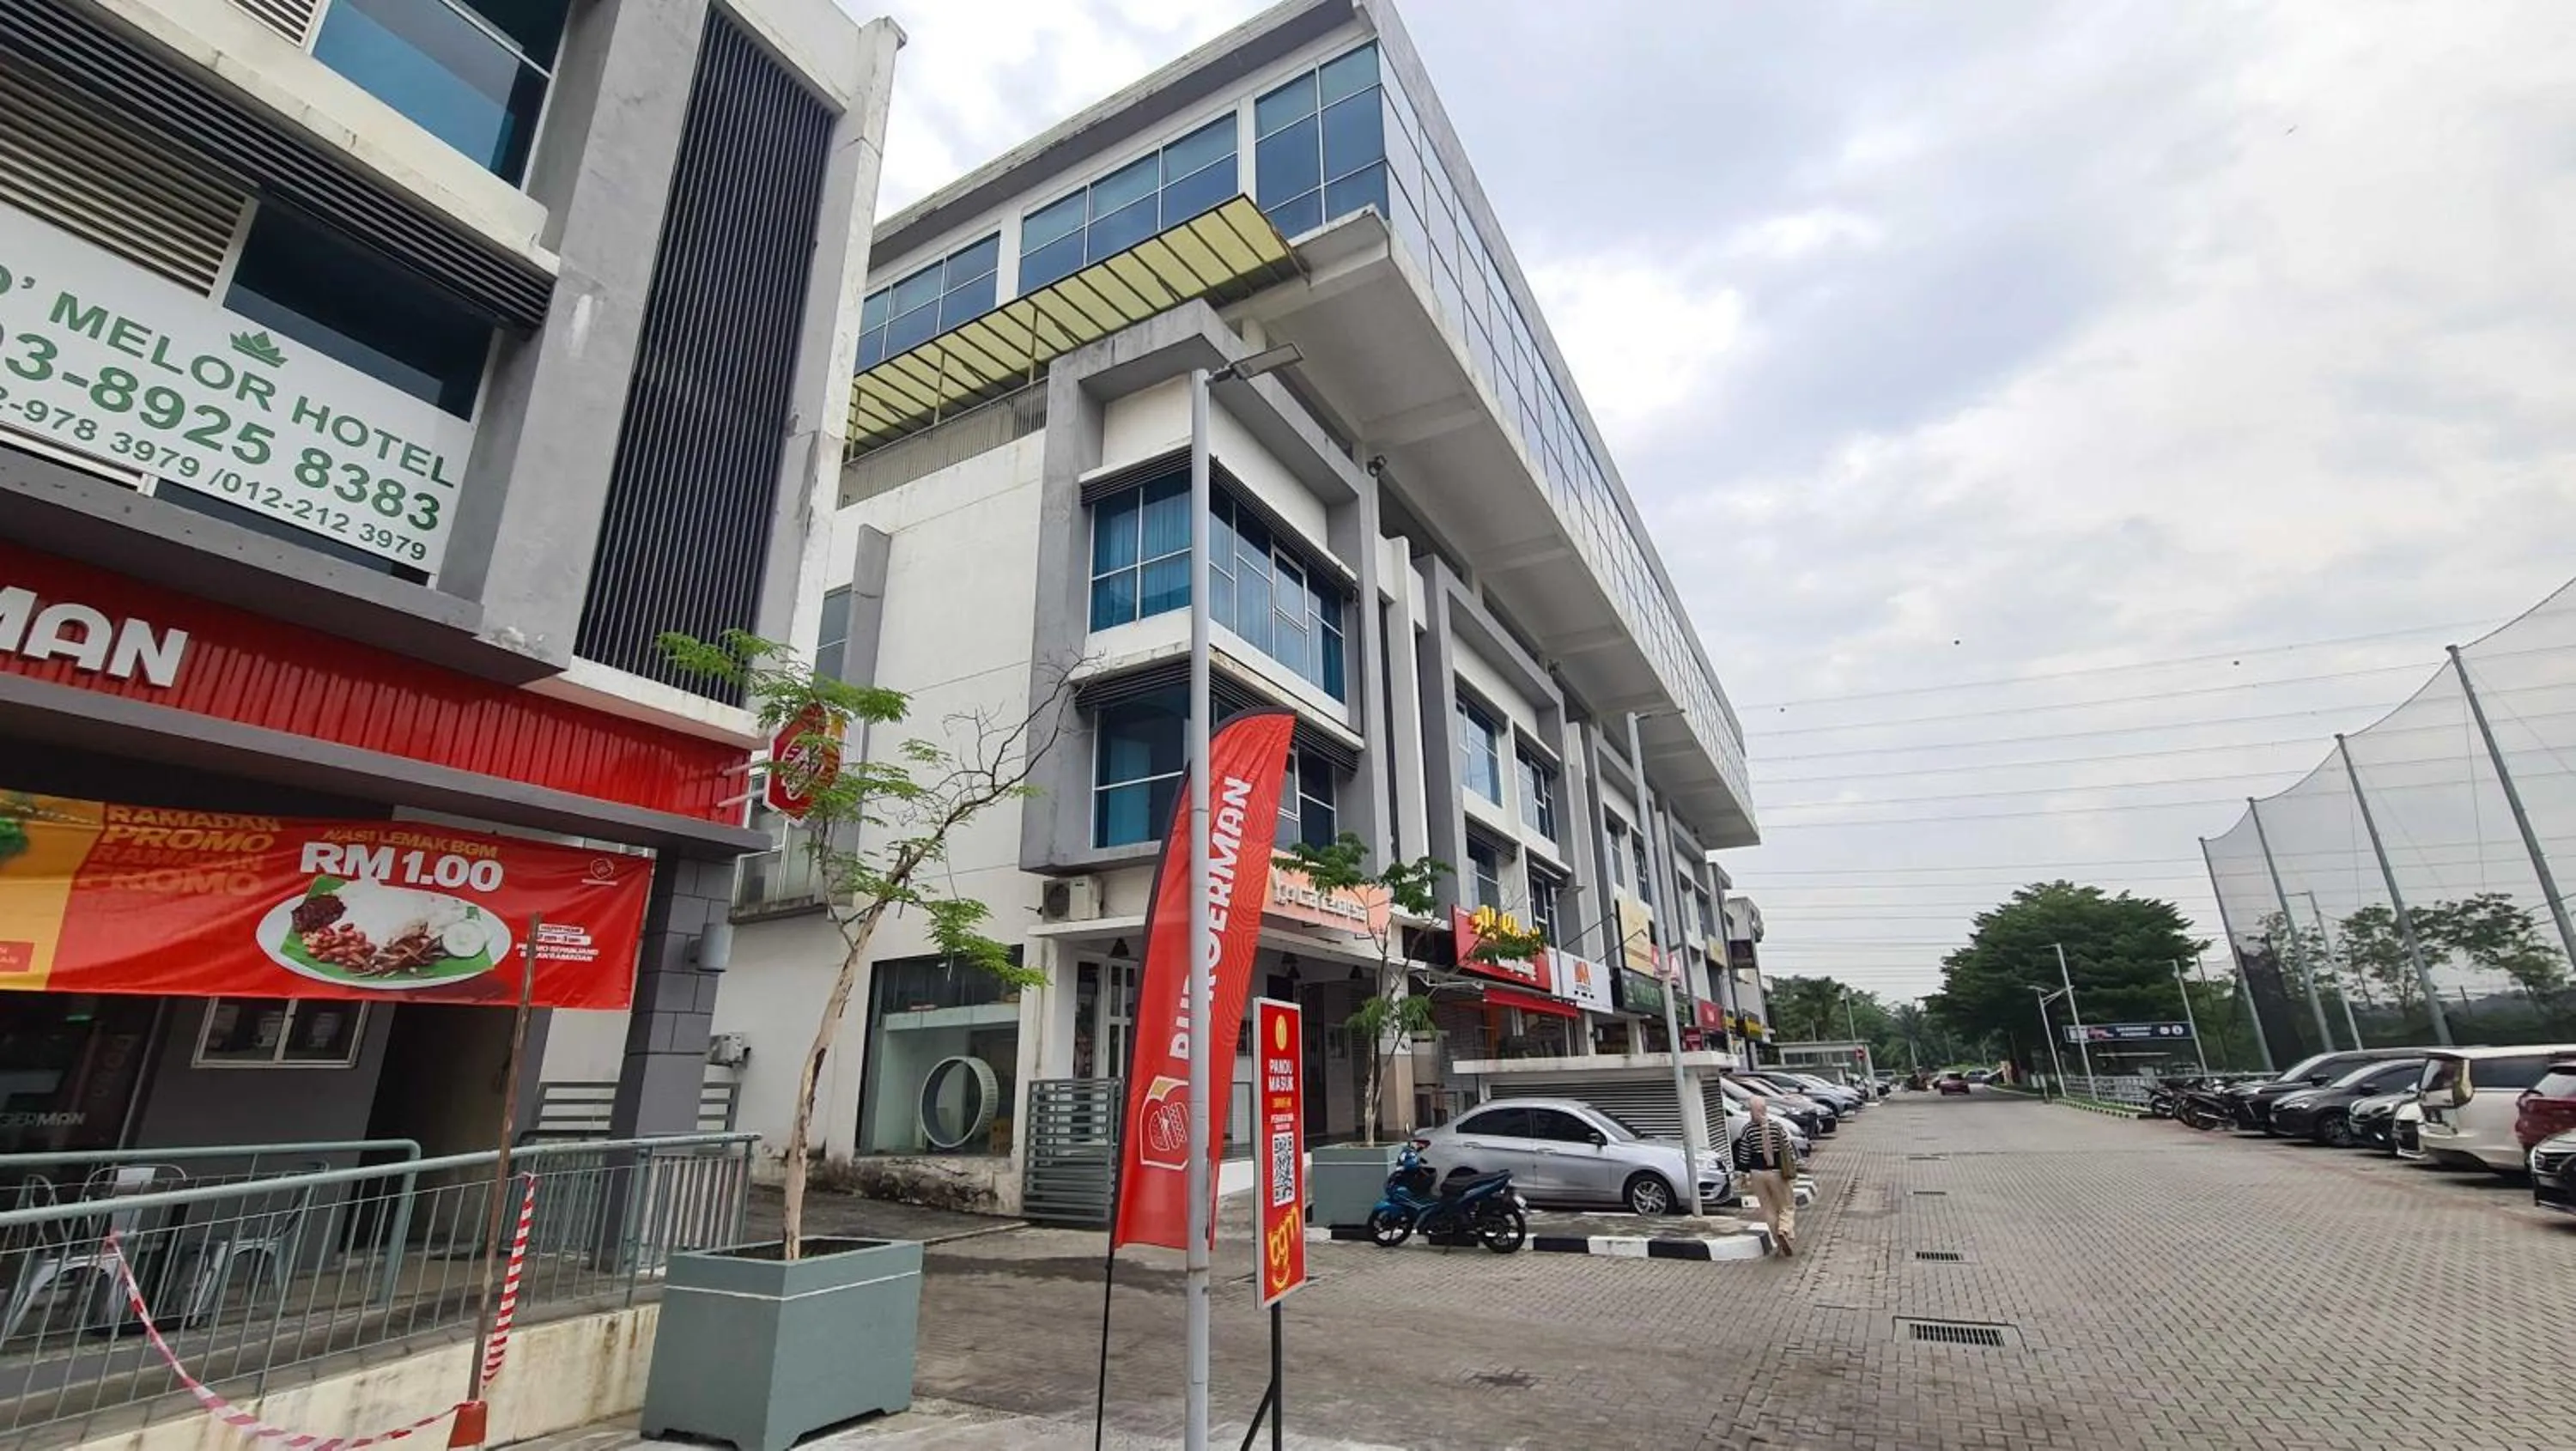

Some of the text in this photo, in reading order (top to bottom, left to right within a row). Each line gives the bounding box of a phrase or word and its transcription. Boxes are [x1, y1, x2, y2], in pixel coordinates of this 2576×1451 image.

[48, 291, 276, 412] MELOR
[291, 395, 455, 488] HOTEL
[0, 321, 441, 531] 3-8925 8383
[110, 432, 200, 477] 3979
[208, 467, 349, 533] /012-212
[358, 522, 426, 562] 3979
[99, 823, 275, 853] PROMO
[107, 805, 283, 832] RAMADAN
[321, 829, 499, 858] NASI LEMAK BGM
[301, 841, 504, 893] RM 1.00
